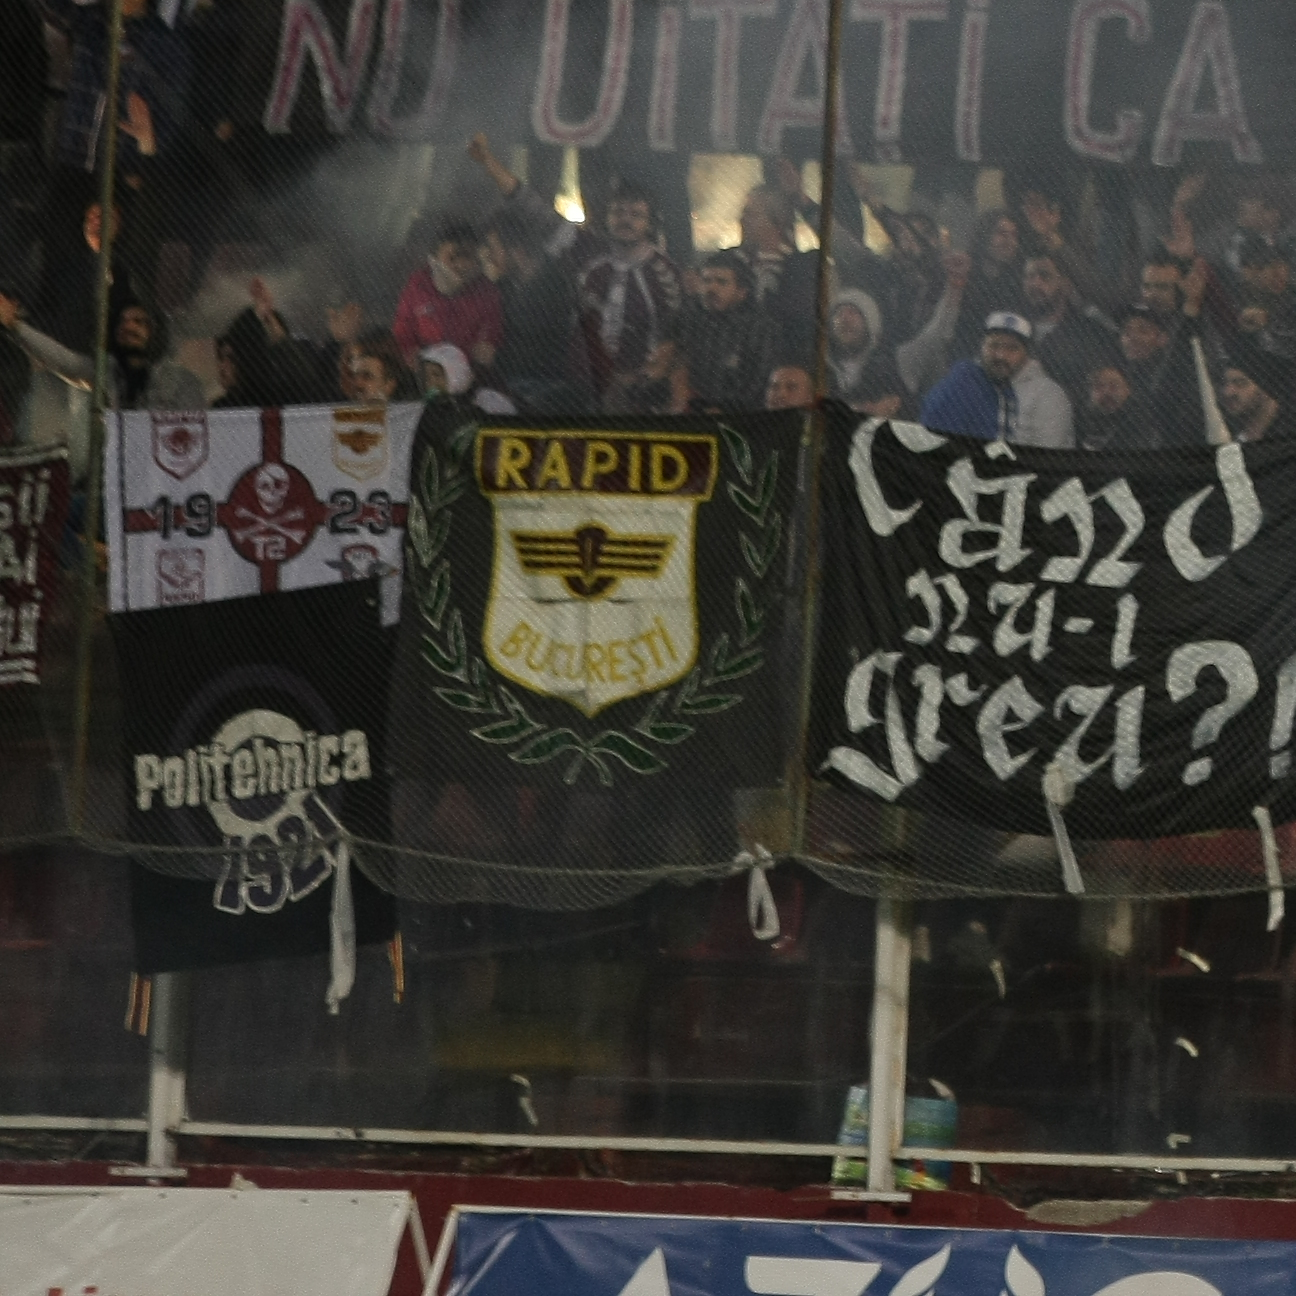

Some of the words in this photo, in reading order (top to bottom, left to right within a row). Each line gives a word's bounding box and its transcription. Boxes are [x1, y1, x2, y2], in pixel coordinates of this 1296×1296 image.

[497, 436, 689, 491] RAPID
[157, 492, 213, 540] 19
[328, 489, 392, 535] 23
